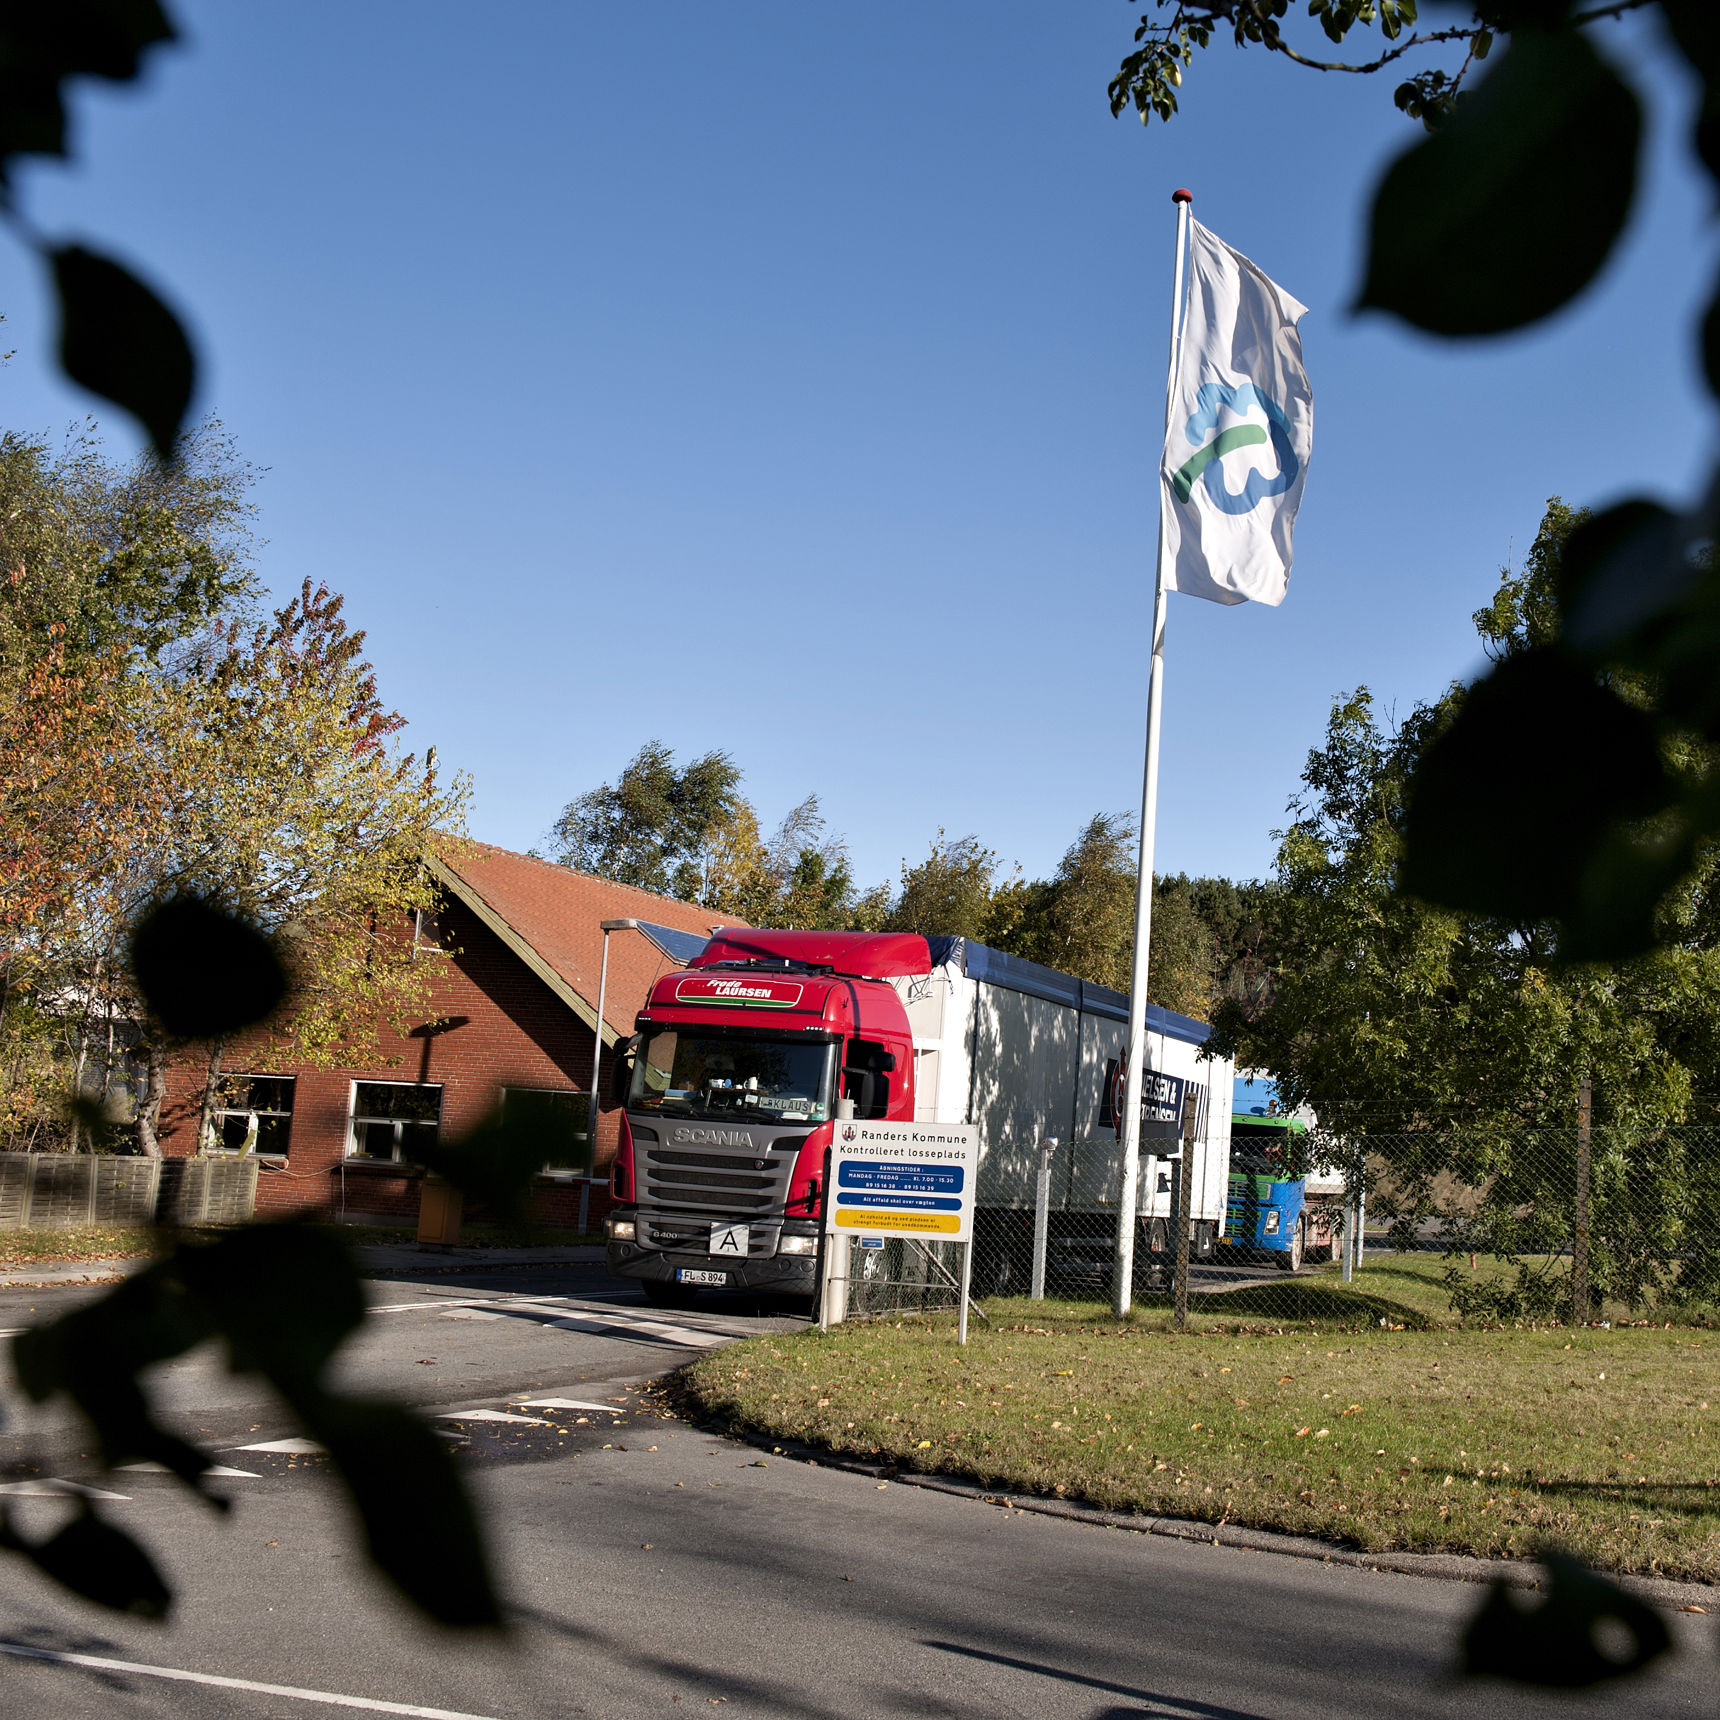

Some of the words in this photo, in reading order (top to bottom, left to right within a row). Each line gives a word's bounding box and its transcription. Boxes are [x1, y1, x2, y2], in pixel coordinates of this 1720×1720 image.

[706, 979, 742, 988] Frode
[715, 987, 772, 998] LAURSEN
[1170, 1081, 1177, 1104] &
[773, 1099, 809, 1112] KLAUS
[673, 1127, 753, 1148] SCANIA
[861, 1130, 907, 1142] Randers
[912, 1132, 967, 1144] Kommune
[840, 1145, 904, 1157] Kontrolleret
[908, 1148, 966, 1160] losseplads
[719, 1230, 739, 1251] A
[684, 1270, 696, 1280] FL
[700, 1272, 706, 1281] S
[708, 1272, 723, 1282] 894
